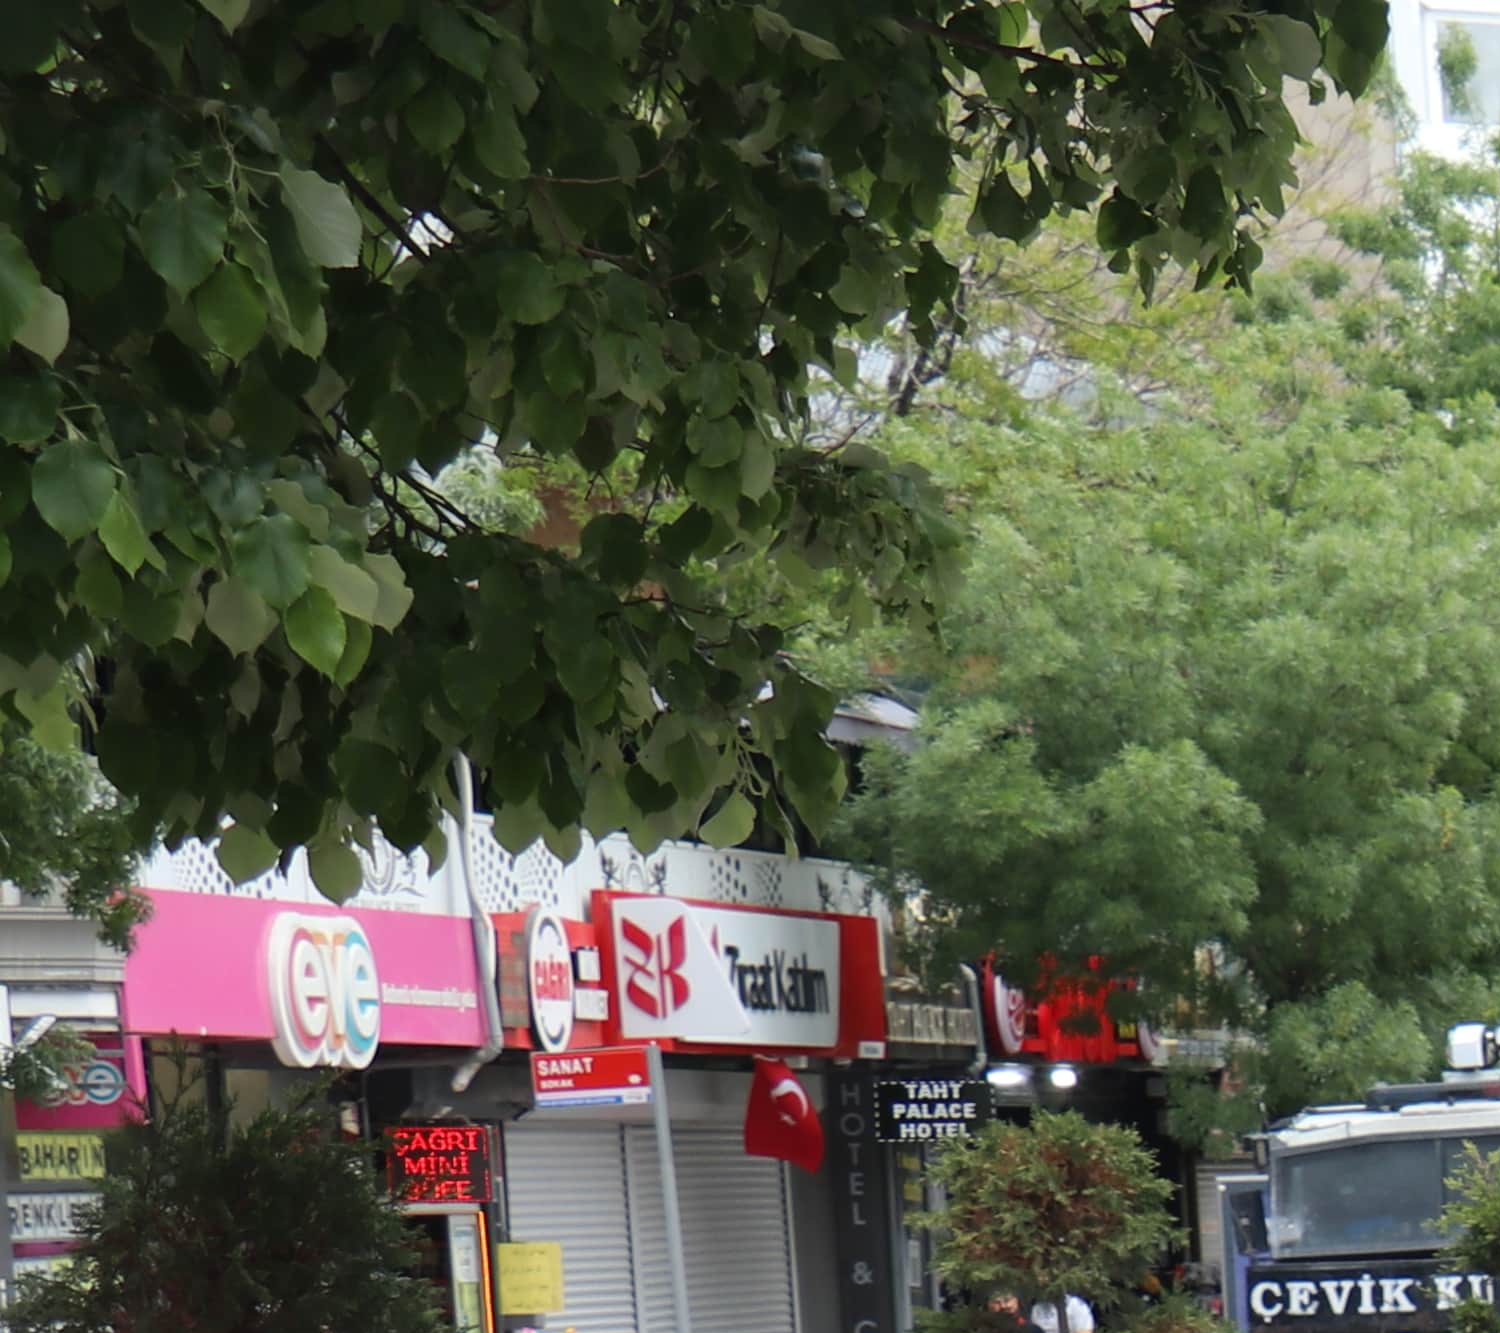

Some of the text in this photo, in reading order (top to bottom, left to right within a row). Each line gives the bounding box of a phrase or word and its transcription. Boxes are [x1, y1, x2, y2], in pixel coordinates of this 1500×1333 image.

[289, 927, 380, 1052] eve
[537, 1057, 592, 1076] SANAT
[540, 1079, 574, 1089] SOKAK
[893, 1103, 976, 1118] PALACE
[393, 1127, 477, 1156] ÇAĞRI
[900, 1123, 970, 1138] HOTEL
[404, 1152, 470, 1175] MİNİ
[839, 1083, 867, 1225] HOTEL
[853, 1261, 873, 1285] &
[1251, 1274, 1417, 1323] ÇEVİK
